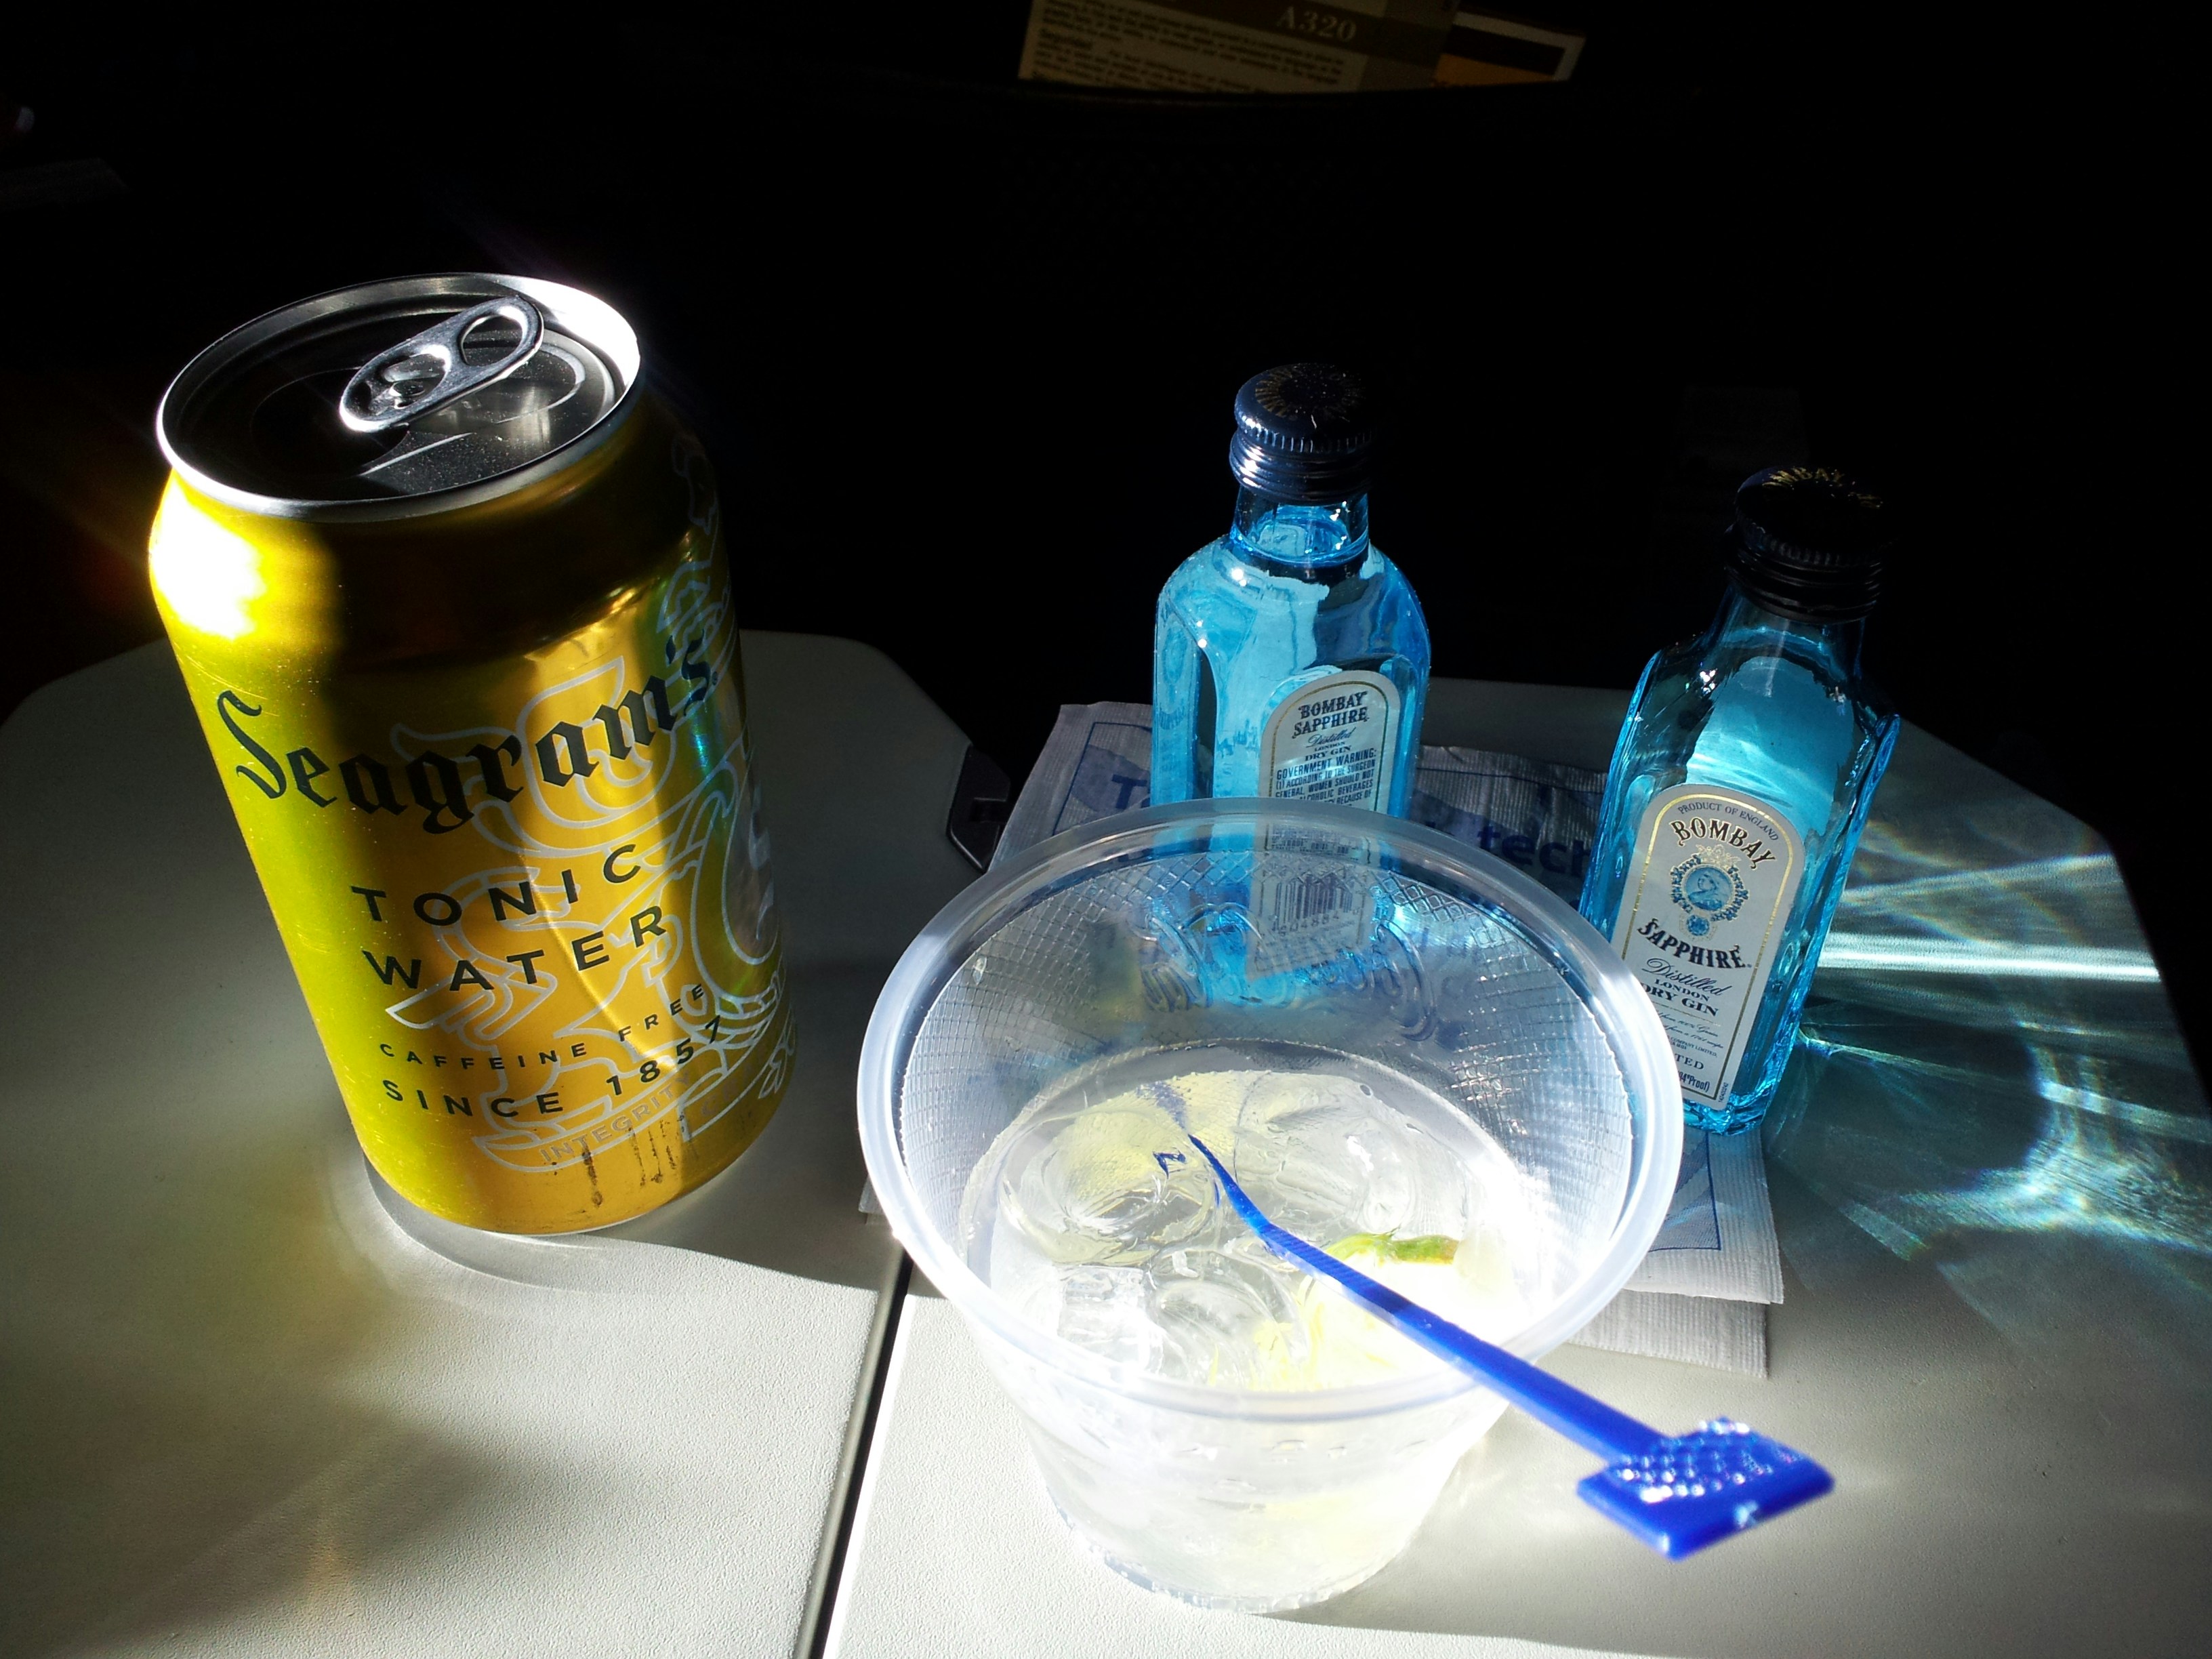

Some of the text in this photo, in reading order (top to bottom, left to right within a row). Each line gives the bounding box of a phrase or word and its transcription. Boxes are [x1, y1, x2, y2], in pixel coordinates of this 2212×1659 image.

[1276, 6, 1357, 42] A320
[1298, 691, 1368, 719] BOMBAY
[217, 628, 712, 834] Seagram's
[1292, 707, 1369, 739] SAPPHIRE
[1305, 726, 1357, 748] Distilled
[1277, 747, 1377, 780] GOVERNMENT WARNING:
[1305, 745, 1352, 761] DRY GIN
[1286, 771, 1322, 788] ACCORDING
[1324, 770, 1332, 779] TO
[1334, 766, 1346, 777] THE
[1347, 759, 1376, 774] SURGEON
[1309, 780, 1332, 793] WOMEN
[1334, 773, 1359, 787] SHOULD
[1362, 769, 1374, 779] NOT
[1338, 779, 1374, 796] BEVERAGES
[1364, 789, 1372, 799] OF
[1677, 802, 1779, 841] PRODUCT OF ENGLAND
[1669, 817, 1776, 870] BOMBAY
[351, 844, 640, 926] TONIC
[363, 905, 666, 991] WATER
[1637, 918, 1746, 969] SAPPHIRE
[1641, 958, 1733, 996] Distilled
[1654, 979, 1711, 1002] LONDON
[1641, 982, 1719, 1017] DRY GIN
[380, 983, 704, 1069] CAFFEINE FREE
[1671, 1036, 1694, 1048] COMPANY
[382, 1080, 563, 1118] SINCE
[606, 1015, 721, 1096] 1857
[539, 1071, 691, 1162] INTEGRITY
